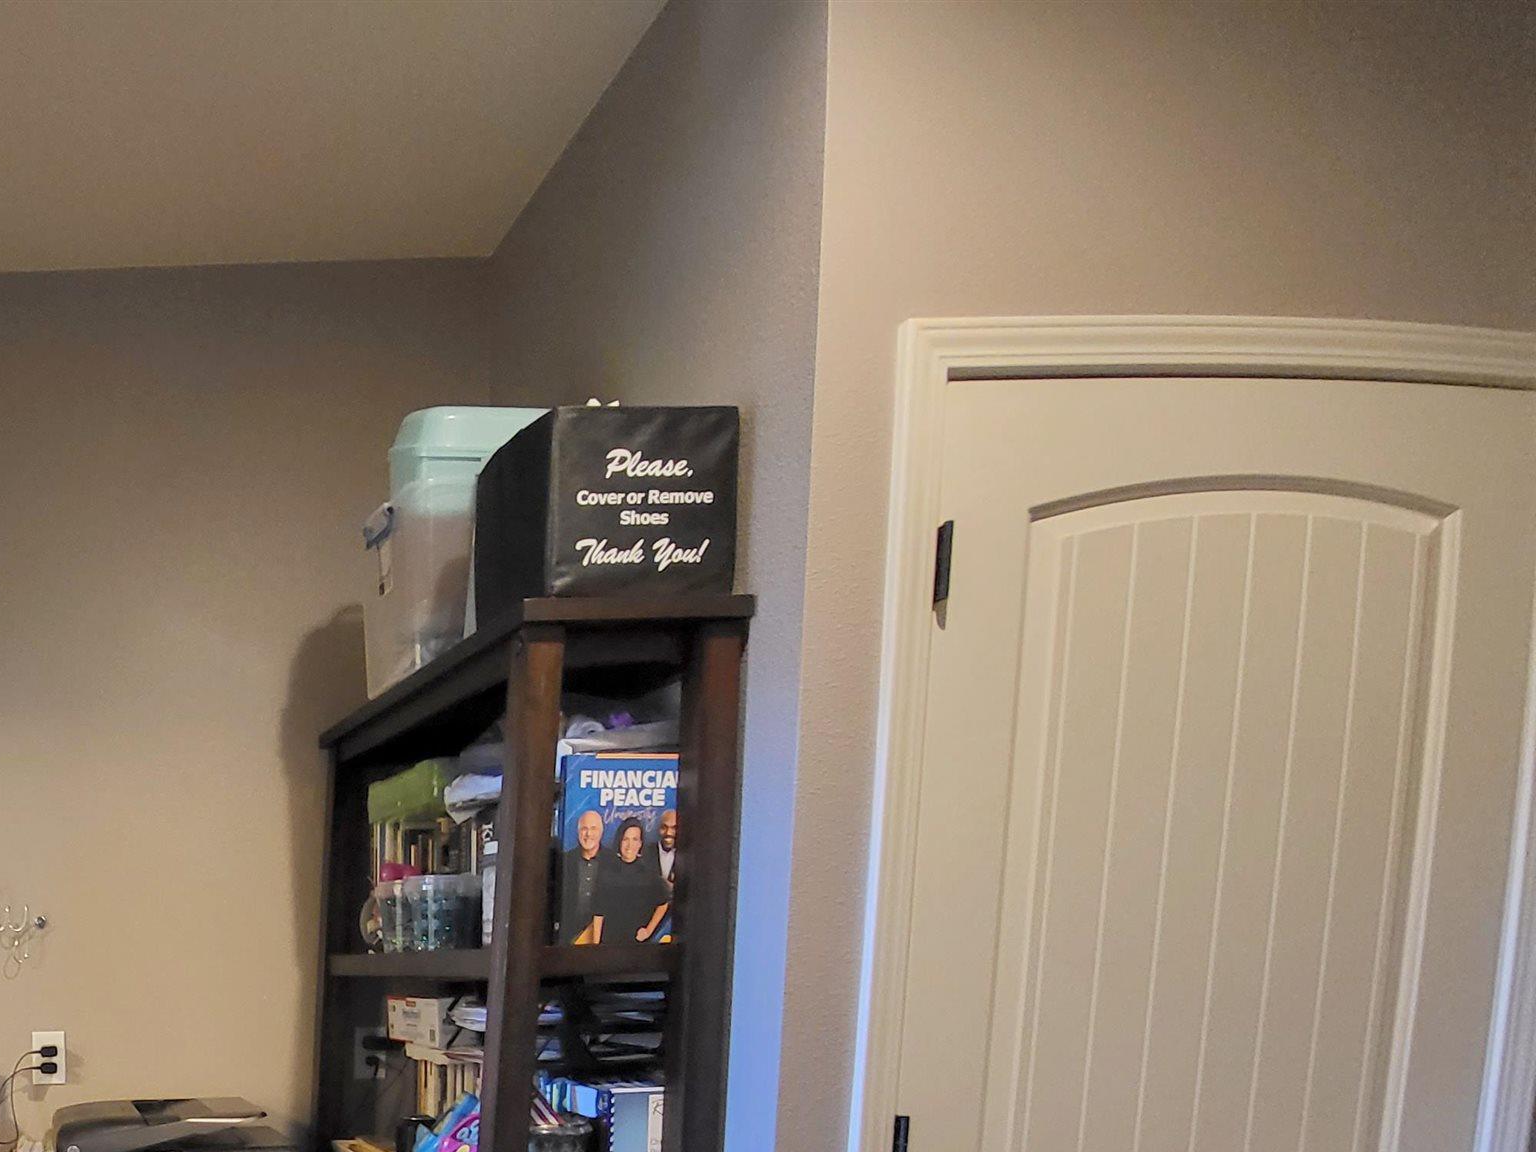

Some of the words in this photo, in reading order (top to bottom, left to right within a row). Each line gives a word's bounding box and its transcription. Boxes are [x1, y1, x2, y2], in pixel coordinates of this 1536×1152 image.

[605, 448, 693, 479] Please,
[576, 489, 625, 505] Cover
[626, 492, 645, 504] or
[648, 489, 714, 504] Remove
[620, 510, 669, 525] Shoes
[575, 539, 645, 566] Thank
[652, 537, 710, 572] You!
[600, 789, 666, 806] PEACE
